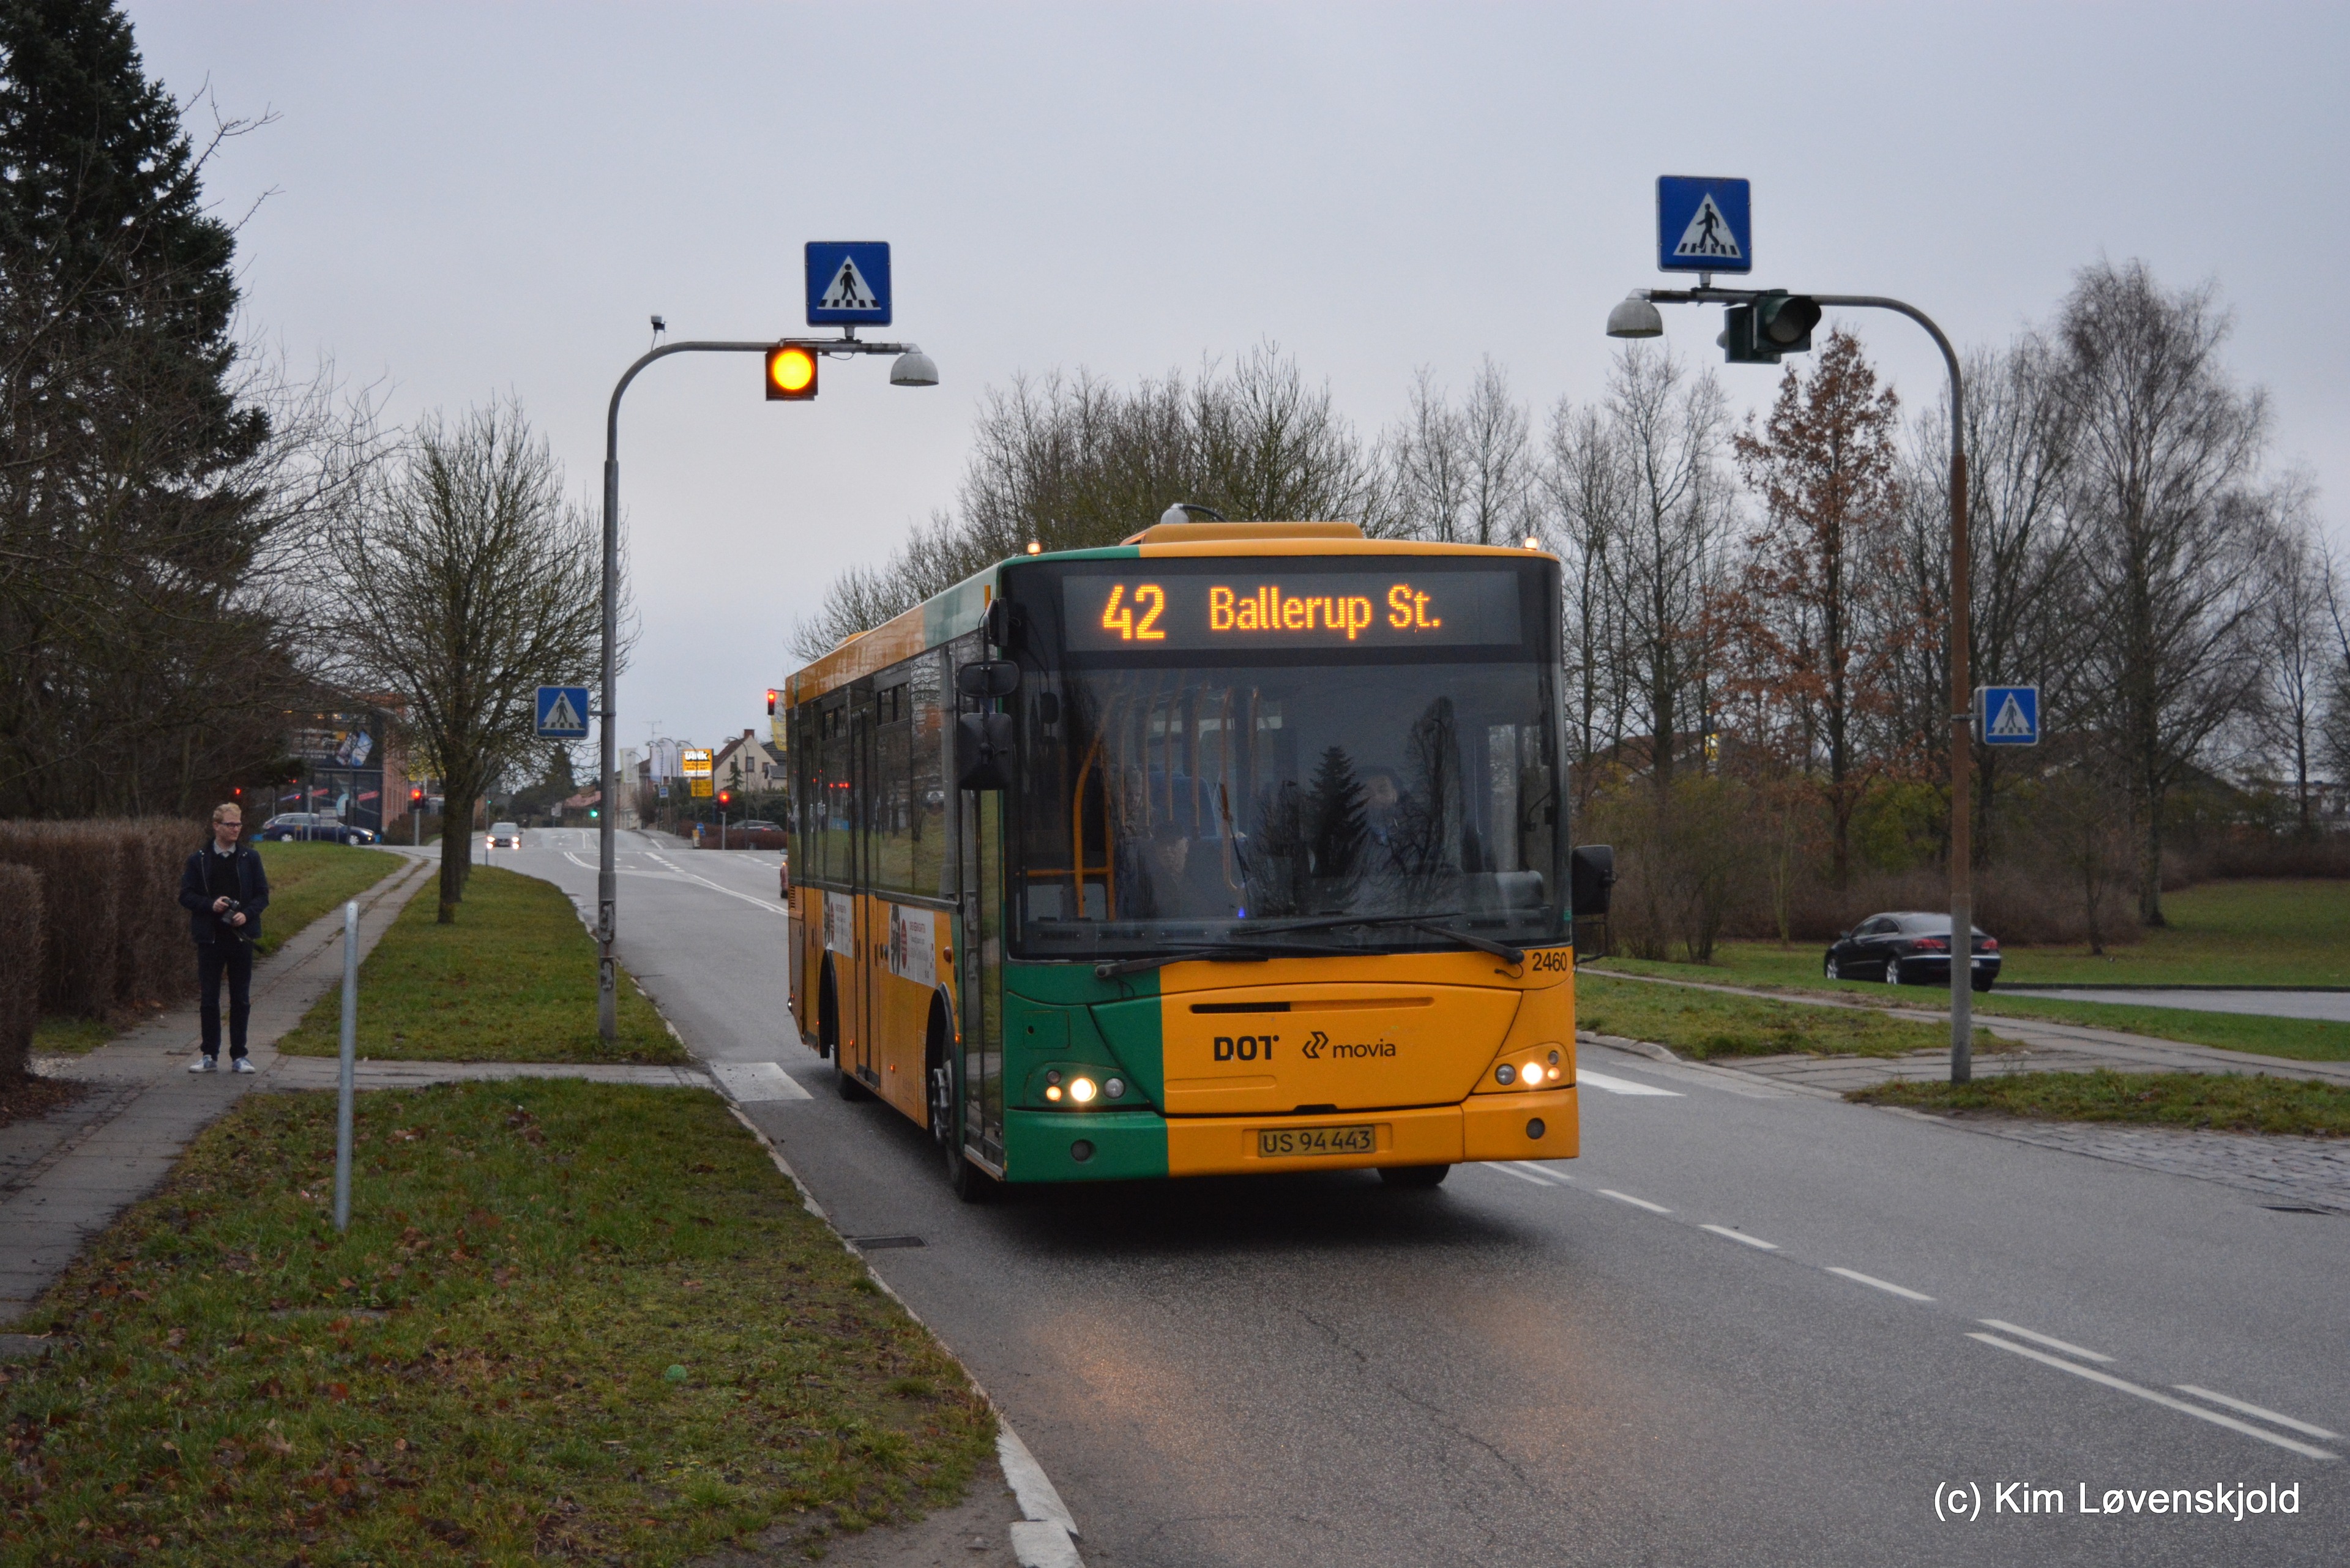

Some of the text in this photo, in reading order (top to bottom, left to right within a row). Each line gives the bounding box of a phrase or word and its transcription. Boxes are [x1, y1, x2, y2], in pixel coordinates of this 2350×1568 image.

[1102, 584, 1441, 641] 42 Ballerup St.
[1532, 952, 1567, 971] 2460
[1333, 1039, 1396, 1058] movia
[1263, 1134, 1294, 1152] US
